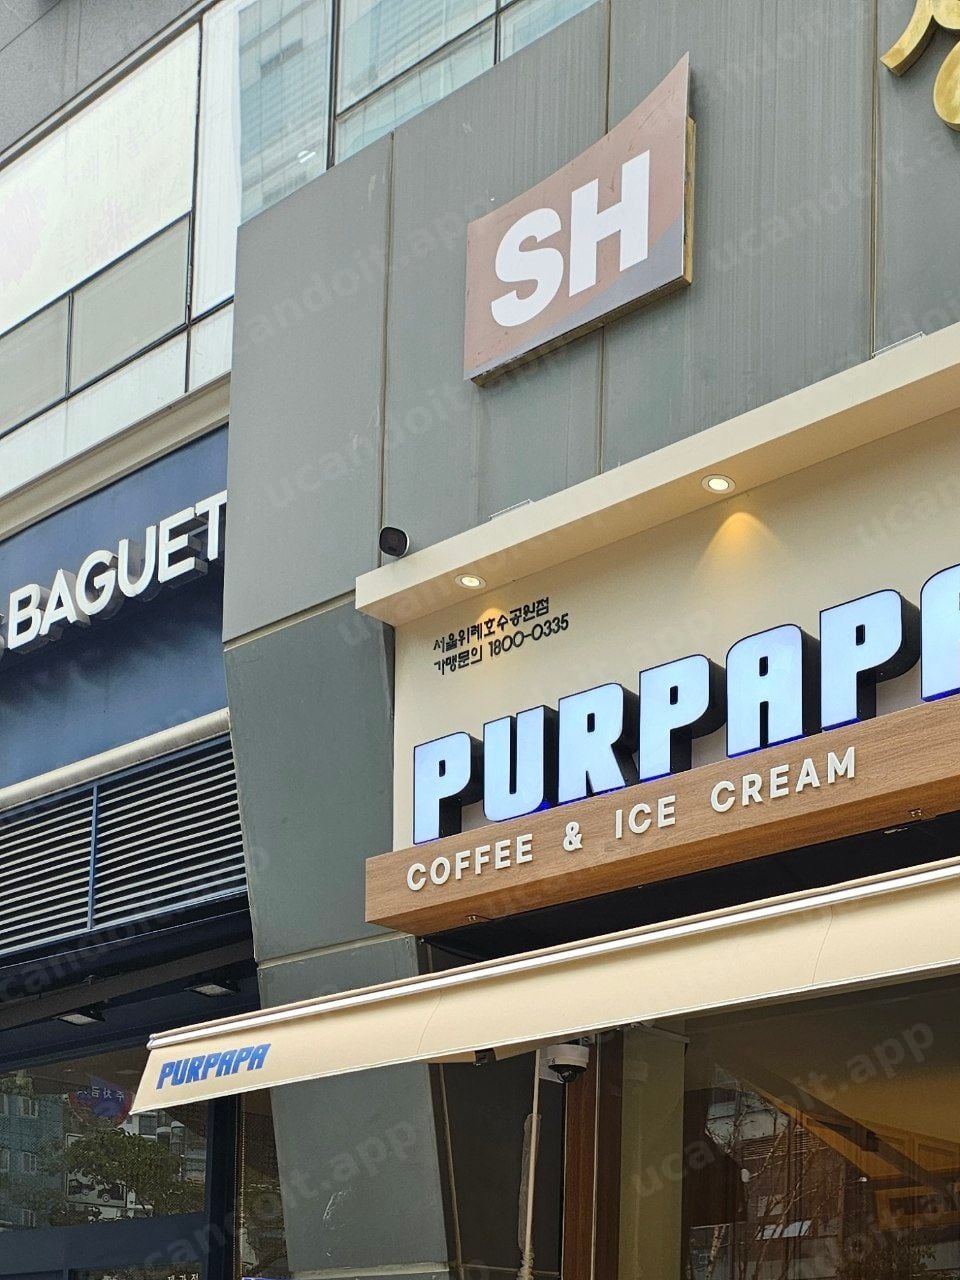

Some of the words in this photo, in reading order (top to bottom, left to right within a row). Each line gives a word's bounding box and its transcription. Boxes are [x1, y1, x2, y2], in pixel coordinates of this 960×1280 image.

[490, 150, 651, 328] SH
[434, 645, 482, 675] 가맹문의
[489, 613, 569, 657] 1800-0335
[406, 834, 533, 891] COFFEE
[562, 820, 583, 852] &
[614, 795, 677, 839] ICE
[711, 747, 855, 813] CREAM
[155, 1043, 272, 1090] PURPAPA
